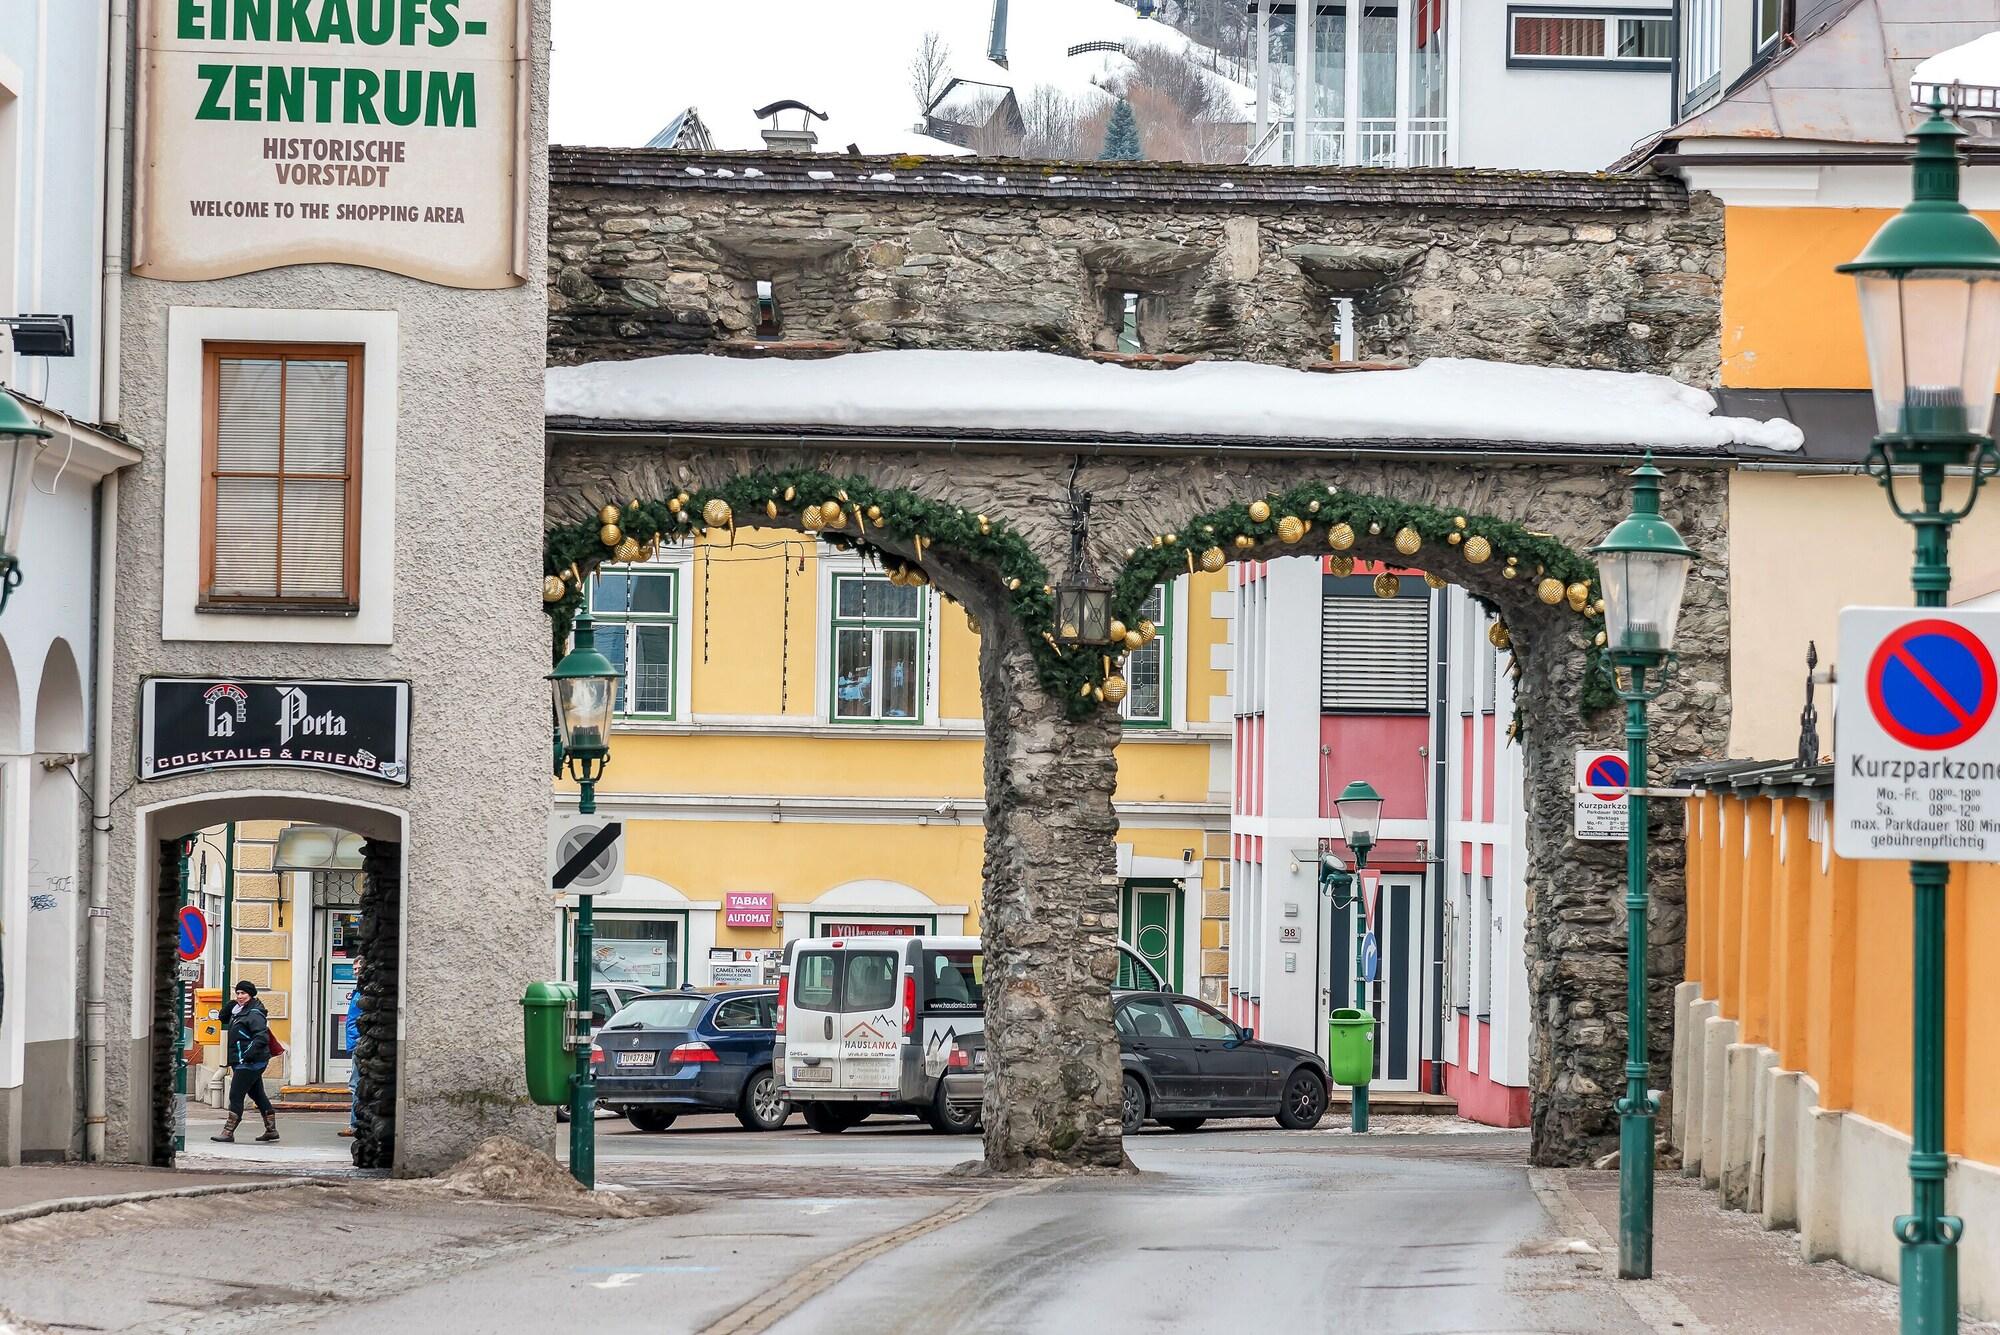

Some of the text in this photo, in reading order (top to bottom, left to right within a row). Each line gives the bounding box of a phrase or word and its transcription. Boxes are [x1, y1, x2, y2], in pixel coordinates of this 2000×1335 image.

[177, 0, 487, 48] EINKAUFS-
[195, 64, 477, 128] ZENTRUM
[263, 138, 405, 163] HISTORISCHE
[275, 163, 390, 188] VORSTADT
[190, 200, 465, 224] WELCOME TO THE SHOPPING AREA
[275, 687, 347, 746] Porta
[157, 748, 271, 769] COCKTAILS
[280, 750, 293, 759] &
[1578, 802, 1628, 810] Kurzparkzo
[1876, 802, 1894, 815] Sa.
[1850, 819, 1880, 831] max.
[1885, 818, 1949, 832] Parkdauer
[1955, 819, 1975, 832] 180
[1871, 833, 1985, 849] gebührenpflichtig
[731, 896, 767, 905] TABAK
[728, 914, 770, 922] AUTOMAT
[1284, 928, 1296, 937] 98
[179, 966, 199, 979] Anfang
[844, 1040, 897, 1050] HAUSLANKA
